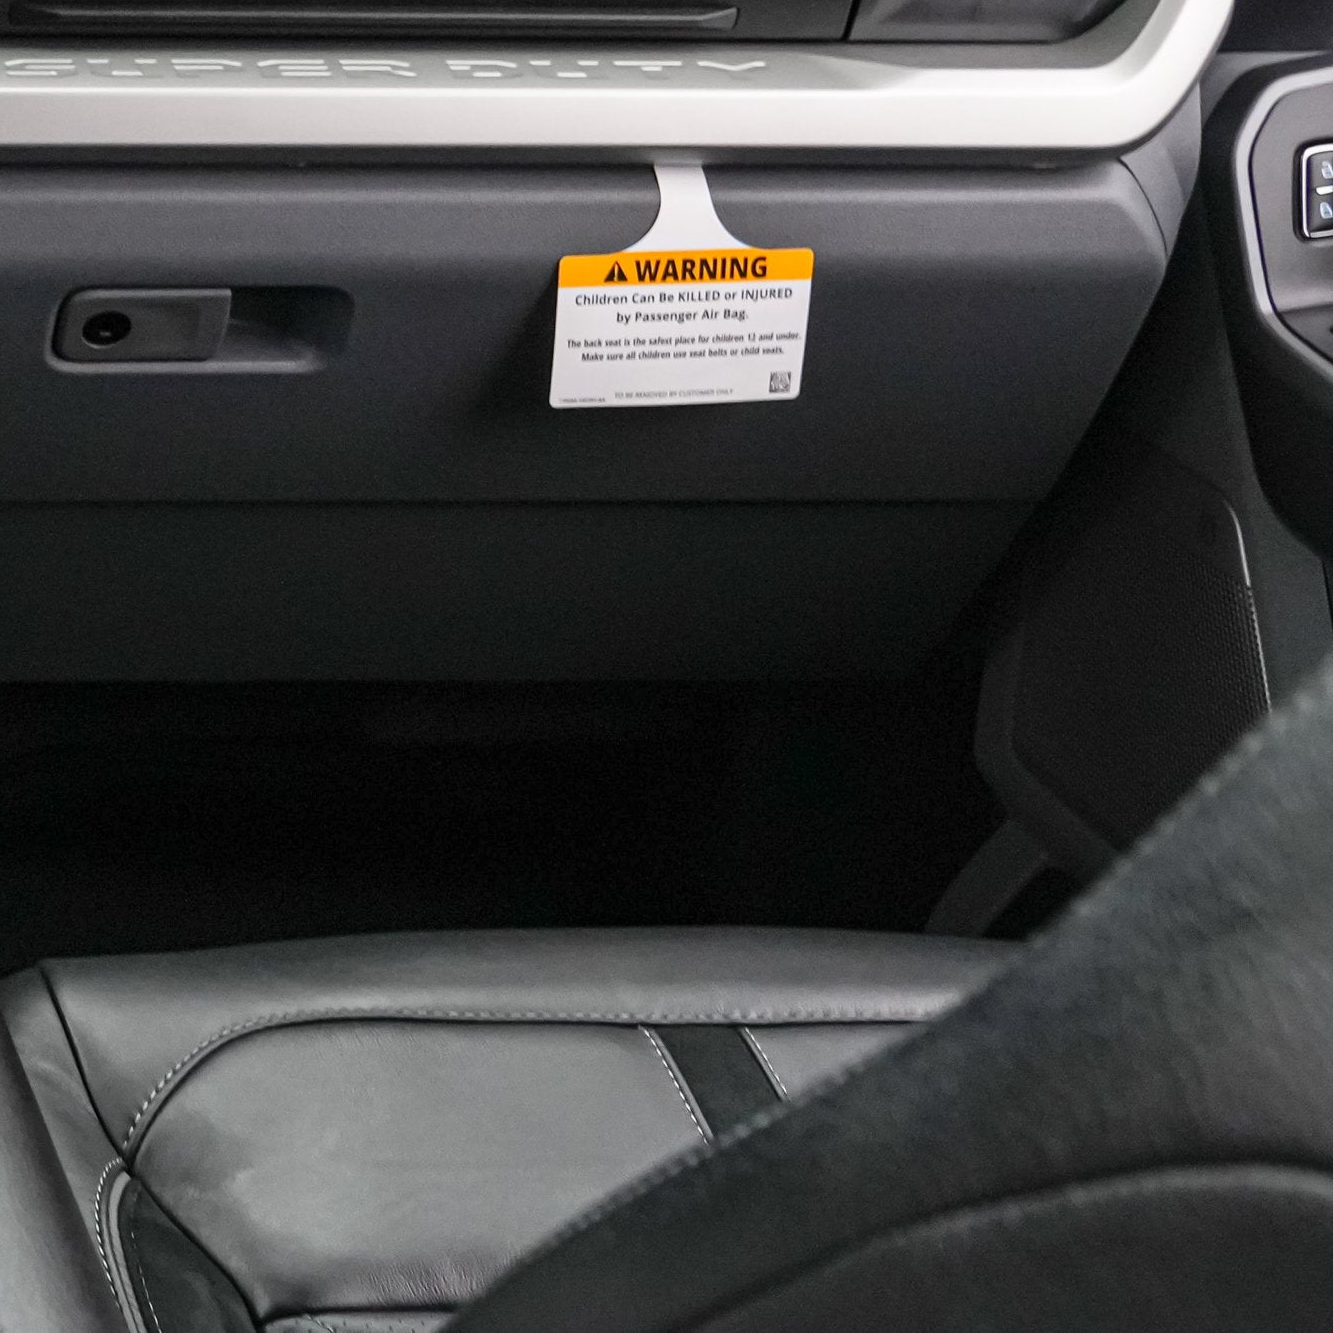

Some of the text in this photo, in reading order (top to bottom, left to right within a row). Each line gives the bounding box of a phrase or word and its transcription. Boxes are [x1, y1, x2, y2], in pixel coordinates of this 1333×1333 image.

[634, 256, 768, 283] WARNING
[575, 288, 793, 307] Children Can Be KILLED or INJURED
[616, 308, 749, 325] by Passenger Air Bag.
[567, 339, 581, 349] The
[584, 338, 602, 348] back
[605, 338, 621, 347] seat
[623, 338, 631, 347] is
[632, 337, 646, 347] the
[648, 336, 673, 346] safest
[674, 335, 696, 348] place
[698, 334, 710, 344] for
[712, 333, 744, 343] children
[758, 332, 774, 342] and
[581, 352, 604, 362] Make
[606, 352, 624, 361] sure
[626, 351, 636, 360] all
[638, 350, 671, 360] children
[673, 351, 687, 359] use
[689, 349, 706, 358] seat
[708, 348, 728, 358] belts
[730, 349, 738, 357] or
[740, 346, 760, 356] child
